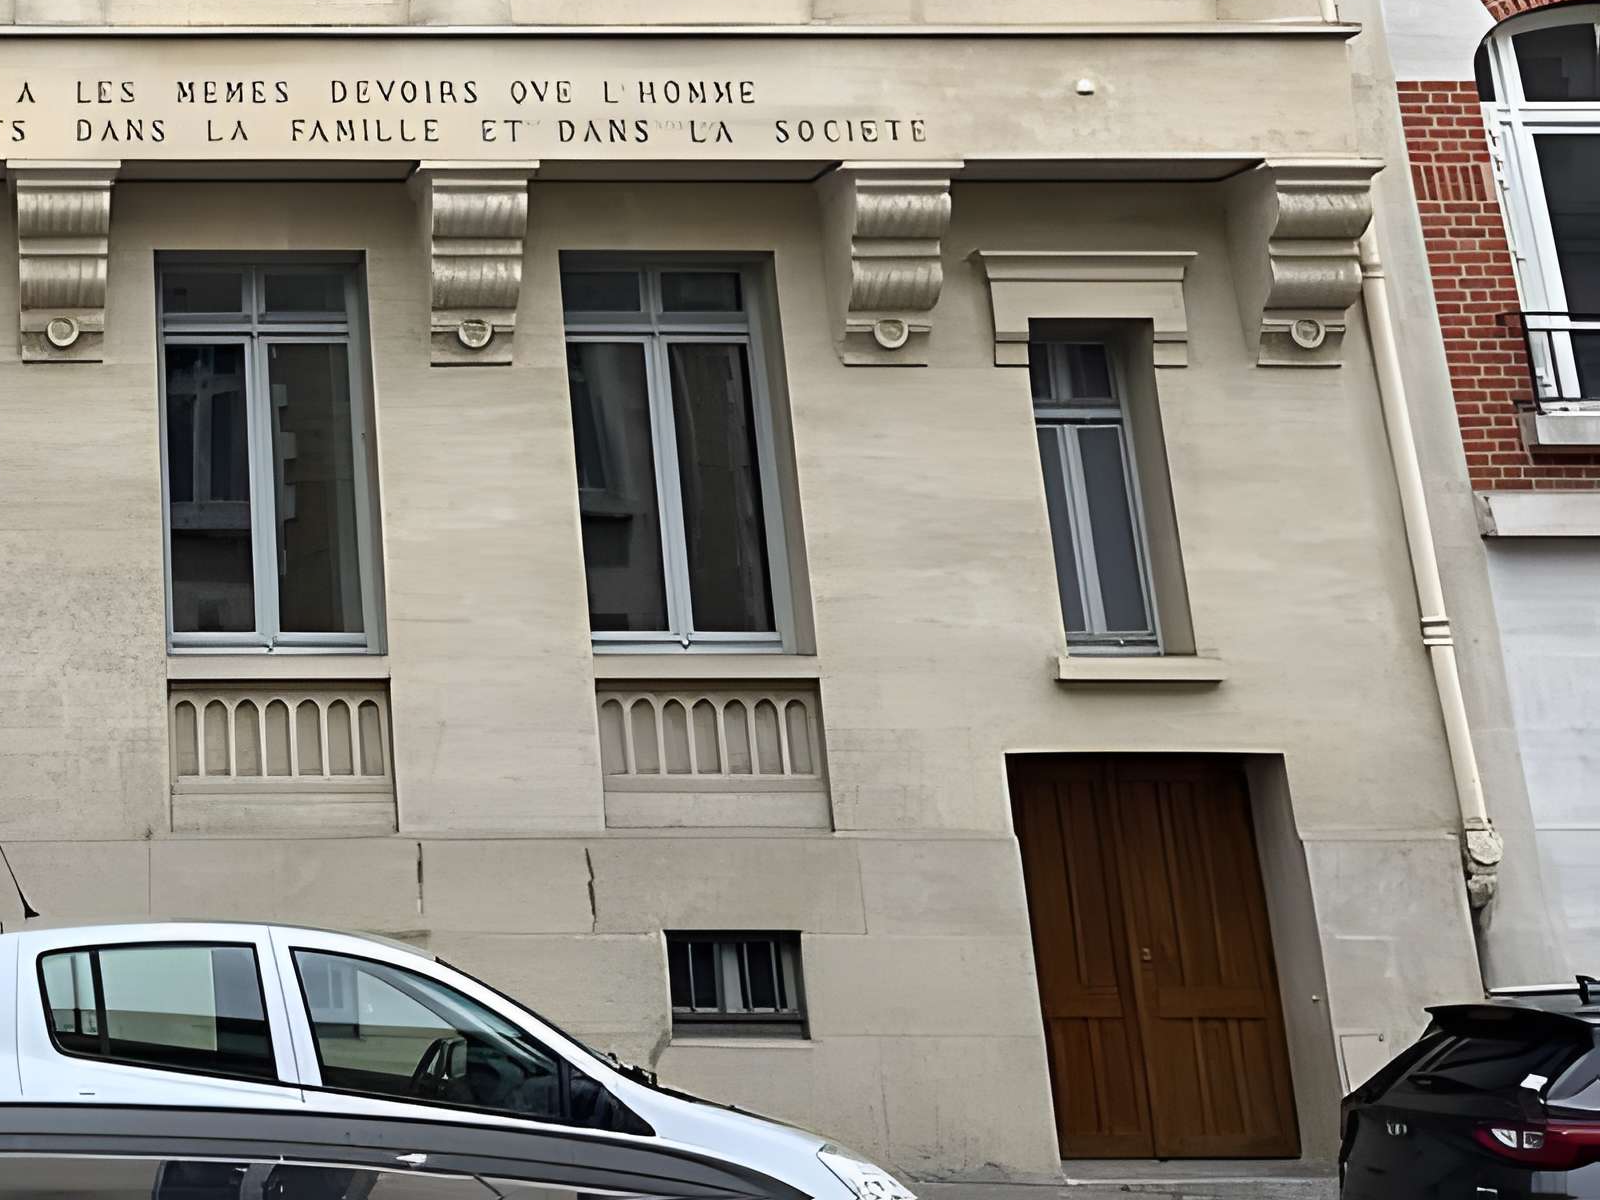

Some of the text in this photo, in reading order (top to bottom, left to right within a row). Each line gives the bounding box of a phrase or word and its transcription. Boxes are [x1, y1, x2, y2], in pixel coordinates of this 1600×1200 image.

[15, 81, 36, 104] A
[76, 80, 136, 104] LES
[176, 80, 289, 104] MEMES
[331, 79, 478, 104] DEVOIRS
[76, 118, 165, 143] DANS
[207, 119, 249, 142] LA
[291, 118, 440, 143] FAMILLE
[481, 119, 523, 143] ET
[557, 118, 649, 144] DANS
[689, 119, 734, 144] LA
[775, 119, 927, 144] SOCIETE
